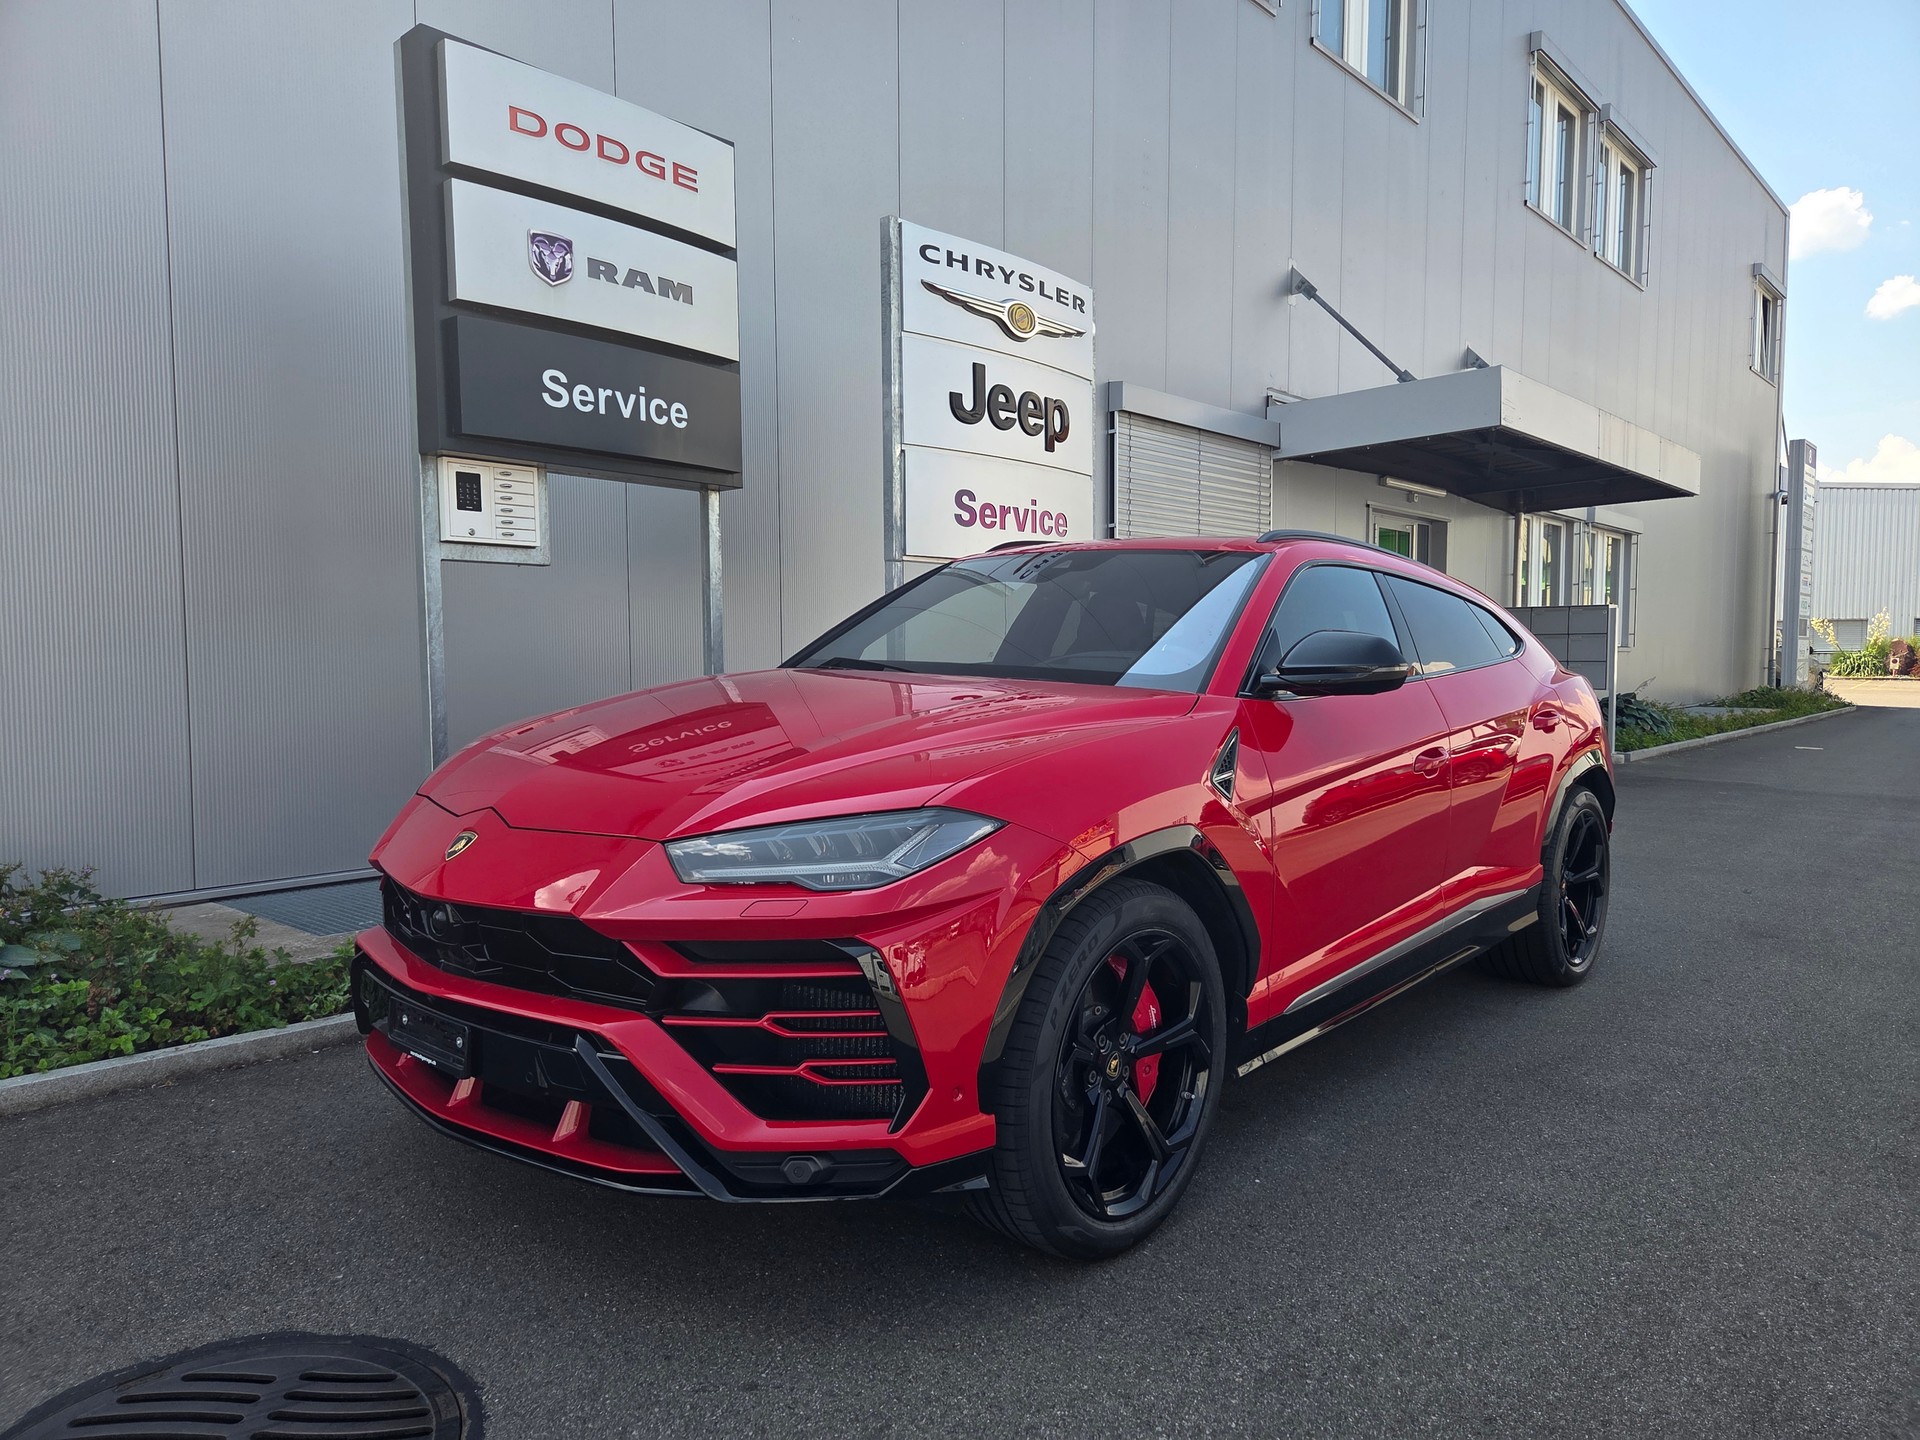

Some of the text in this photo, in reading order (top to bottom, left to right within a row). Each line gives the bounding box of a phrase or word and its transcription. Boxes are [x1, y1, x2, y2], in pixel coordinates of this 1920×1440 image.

[508, 105, 699, 193] DODGE
[586, 256, 694, 306] RAM
[919, 243, 1086, 314] CHRYSLER
[541, 368, 689, 429] Service
[948, 362, 1071, 452] Jeep
[954, 489, 1068, 538] Service
[1049, 933, 1098, 1030] P ZERO
